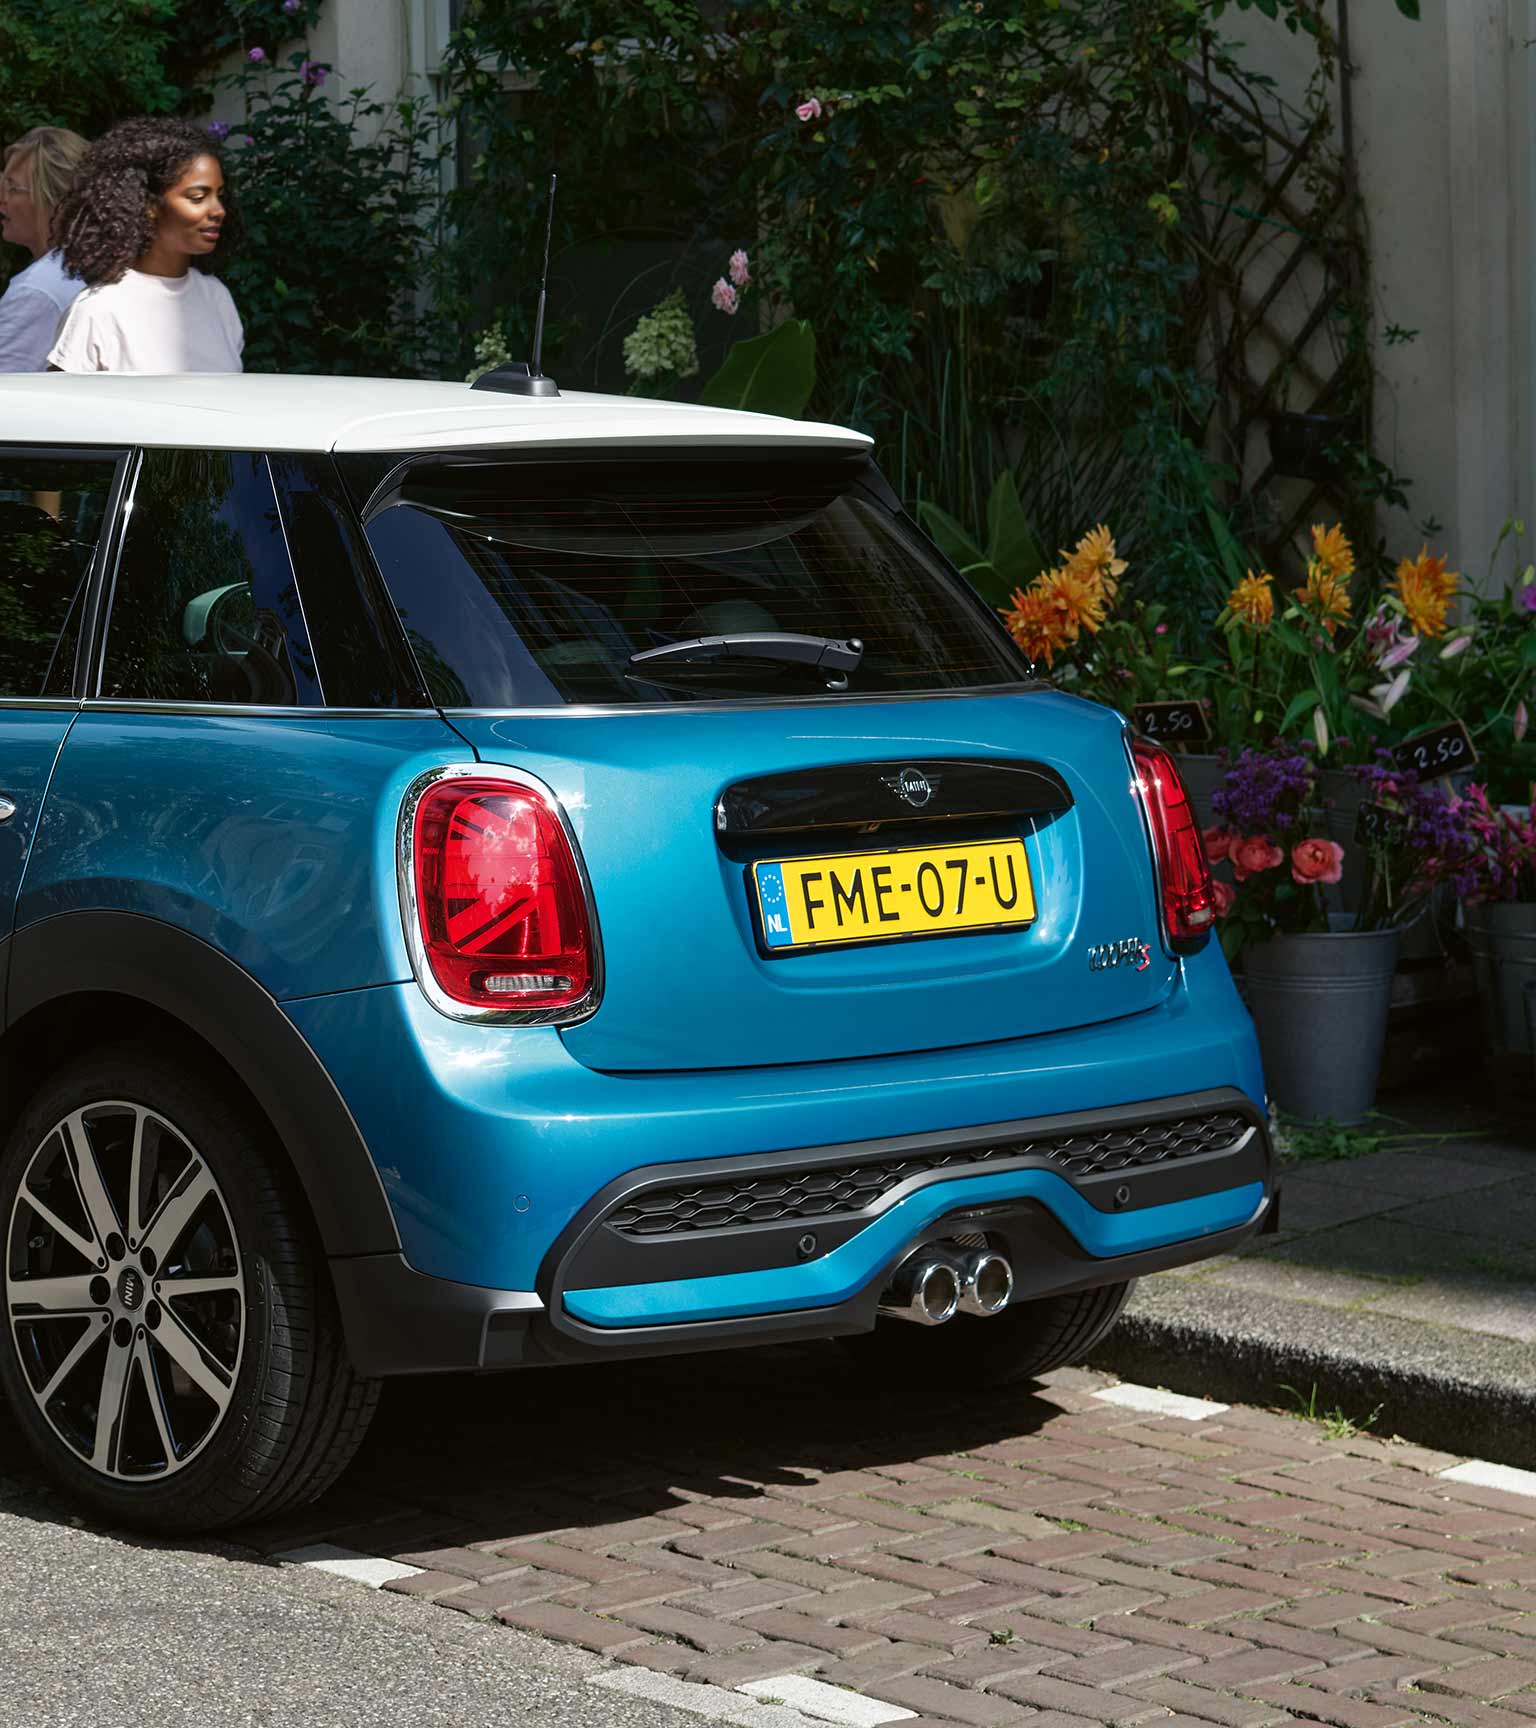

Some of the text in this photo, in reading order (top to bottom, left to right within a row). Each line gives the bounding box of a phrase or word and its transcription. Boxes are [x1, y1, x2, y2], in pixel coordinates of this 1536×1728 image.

[1145, 711, 1193, 733] 2.50
[1414, 737, 1464, 769] 2.50
[800, 855, 1018, 929] FME-07-U
[767, 914, 788, 934] NL
[124, 1273, 135, 1306] MINI
